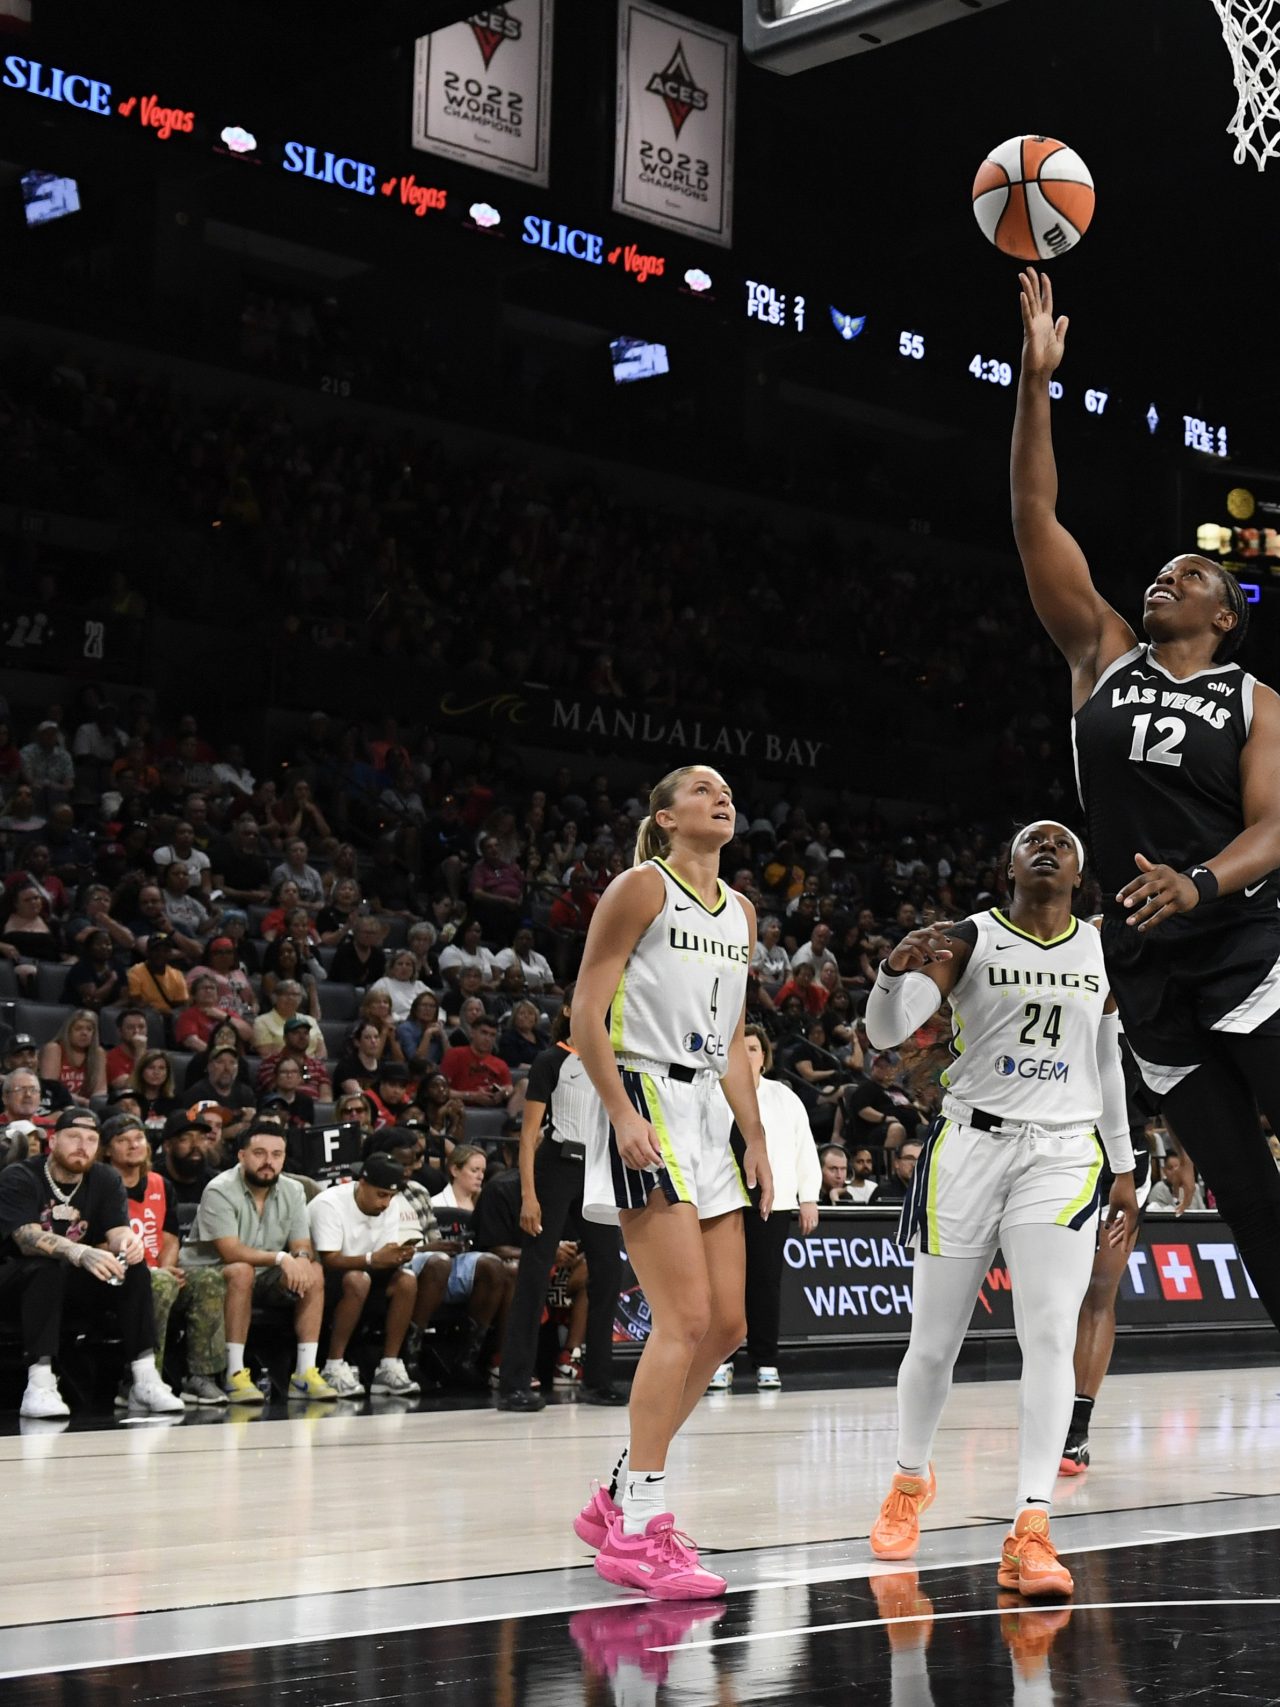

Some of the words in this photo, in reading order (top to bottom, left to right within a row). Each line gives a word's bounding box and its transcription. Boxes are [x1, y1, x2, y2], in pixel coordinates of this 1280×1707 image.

[472, 11, 521, 39] CES
[3, 56, 111, 115] SLICE
[118, 97, 137, 117] of
[140, 95, 194, 139] Vegas
[444, 71, 523, 112] 2022
[651, 76, 707, 110] ACES
[443, 105, 522, 138] CHAMPIONS
[445, 90, 522, 127] WORLD
[640, 140, 709, 178] 2023
[641, 158, 708, 192] WORLD
[283, 142, 375, 195] SLICE
[381, 178, 398, 197] of
[400, 175, 447, 216] Vegas
[639, 173, 708, 202] CHAMPIONS
[522, 216, 603, 265] SLICE
[608, 247, 622, 265] of
[624, 244, 665, 283] Vegas
[745, 280, 786, 309] TOL:
[794, 296, 805, 315] 2
[747, 299, 786, 326] FLS:
[795, 314, 804, 332] 1
[899, 331, 925, 360] 55
[968, 354, 1012, 386] 4:39
[1084, 389, 1108, 414] 67
[1183, 415, 1214, 438] TOL:
[1217, 426, 1227, 441] 4
[1184, 431, 1214, 454] FLS:
[1218, 441, 1227, 457] 3
[1207, 682, 1236, 697] ally
[1112, 686, 1157, 708] LAS
[1160, 691, 1232, 730] VEGAS
[552, 699, 754, 757] MANDALAY
[764, 733, 825, 768] BAY
[1128, 713, 1187, 767] 12
[670, 928, 749, 964] WINGS
[988, 967, 1100, 993] WINGS
[1020, 1003, 1062, 1048] 24
[704, 1034, 725, 1056] GE
[1018, 1058, 1069, 1083] GEM
[323, 1129, 340, 1163] F
[783, 1238, 914, 1268] OFFICIAL
[804, 1286, 913, 1317] WATCH
